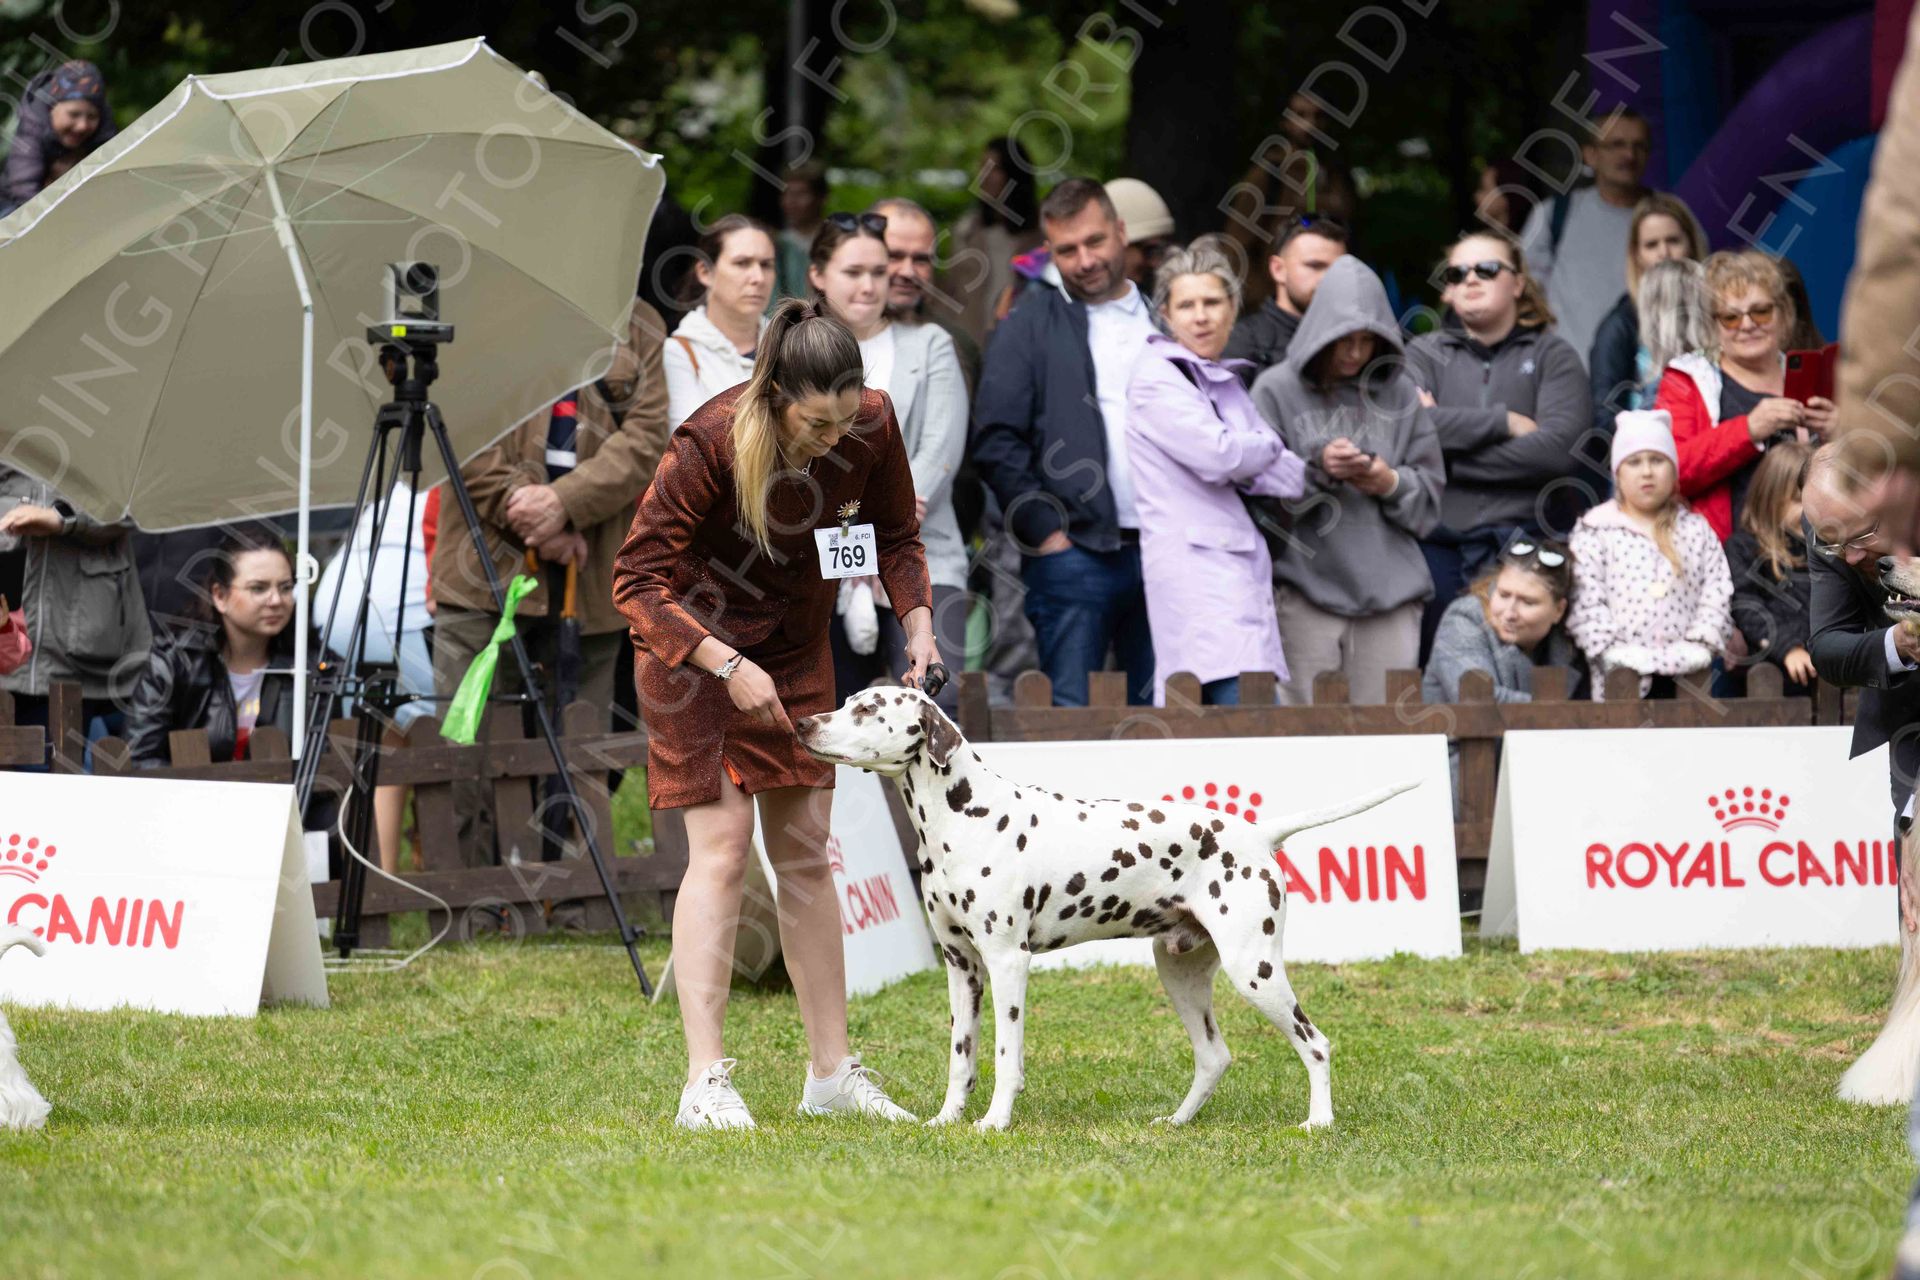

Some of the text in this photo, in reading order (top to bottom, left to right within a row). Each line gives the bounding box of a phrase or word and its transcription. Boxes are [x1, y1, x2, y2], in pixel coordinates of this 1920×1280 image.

[829, 545, 866, 569] 769
[1275, 845, 1427, 903] ANIN
[1585, 841, 1745, 889] ROYAL
[7, 893, 185, 950] CANIN
[845, 872, 900, 931] CANIN
